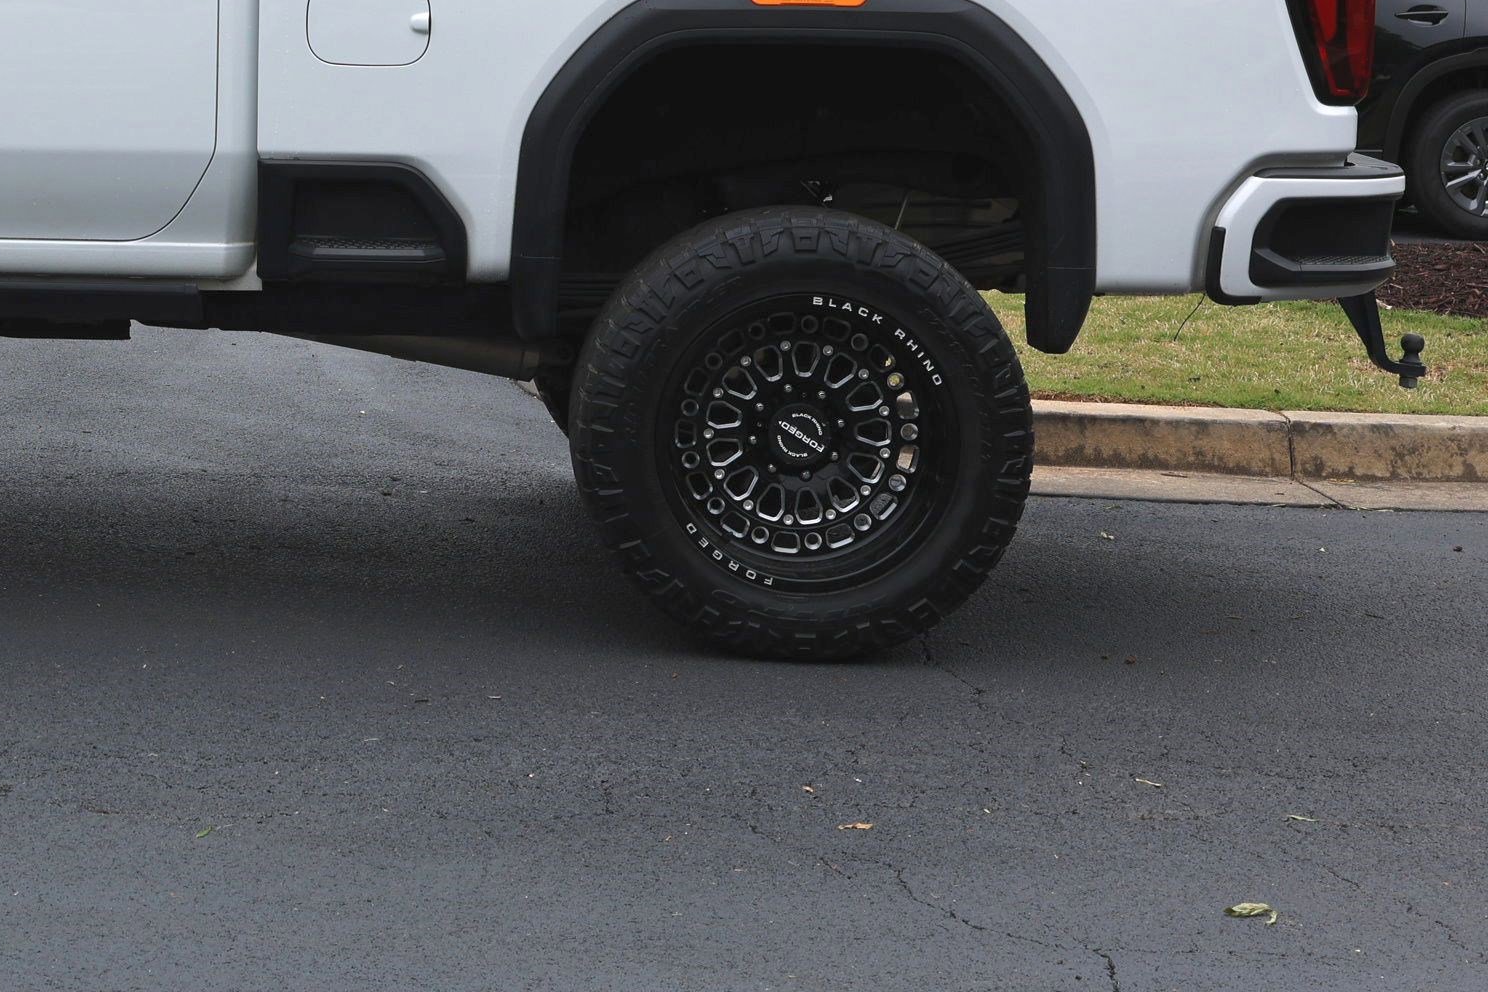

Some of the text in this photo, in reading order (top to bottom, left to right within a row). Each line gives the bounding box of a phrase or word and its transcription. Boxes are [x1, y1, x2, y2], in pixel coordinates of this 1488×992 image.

[812, 296, 883, 324] BLACK
[894, 328, 943, 386] RHINO
[780, 421, 825, 453] FORGED
[686, 522, 773, 586] FORGED
